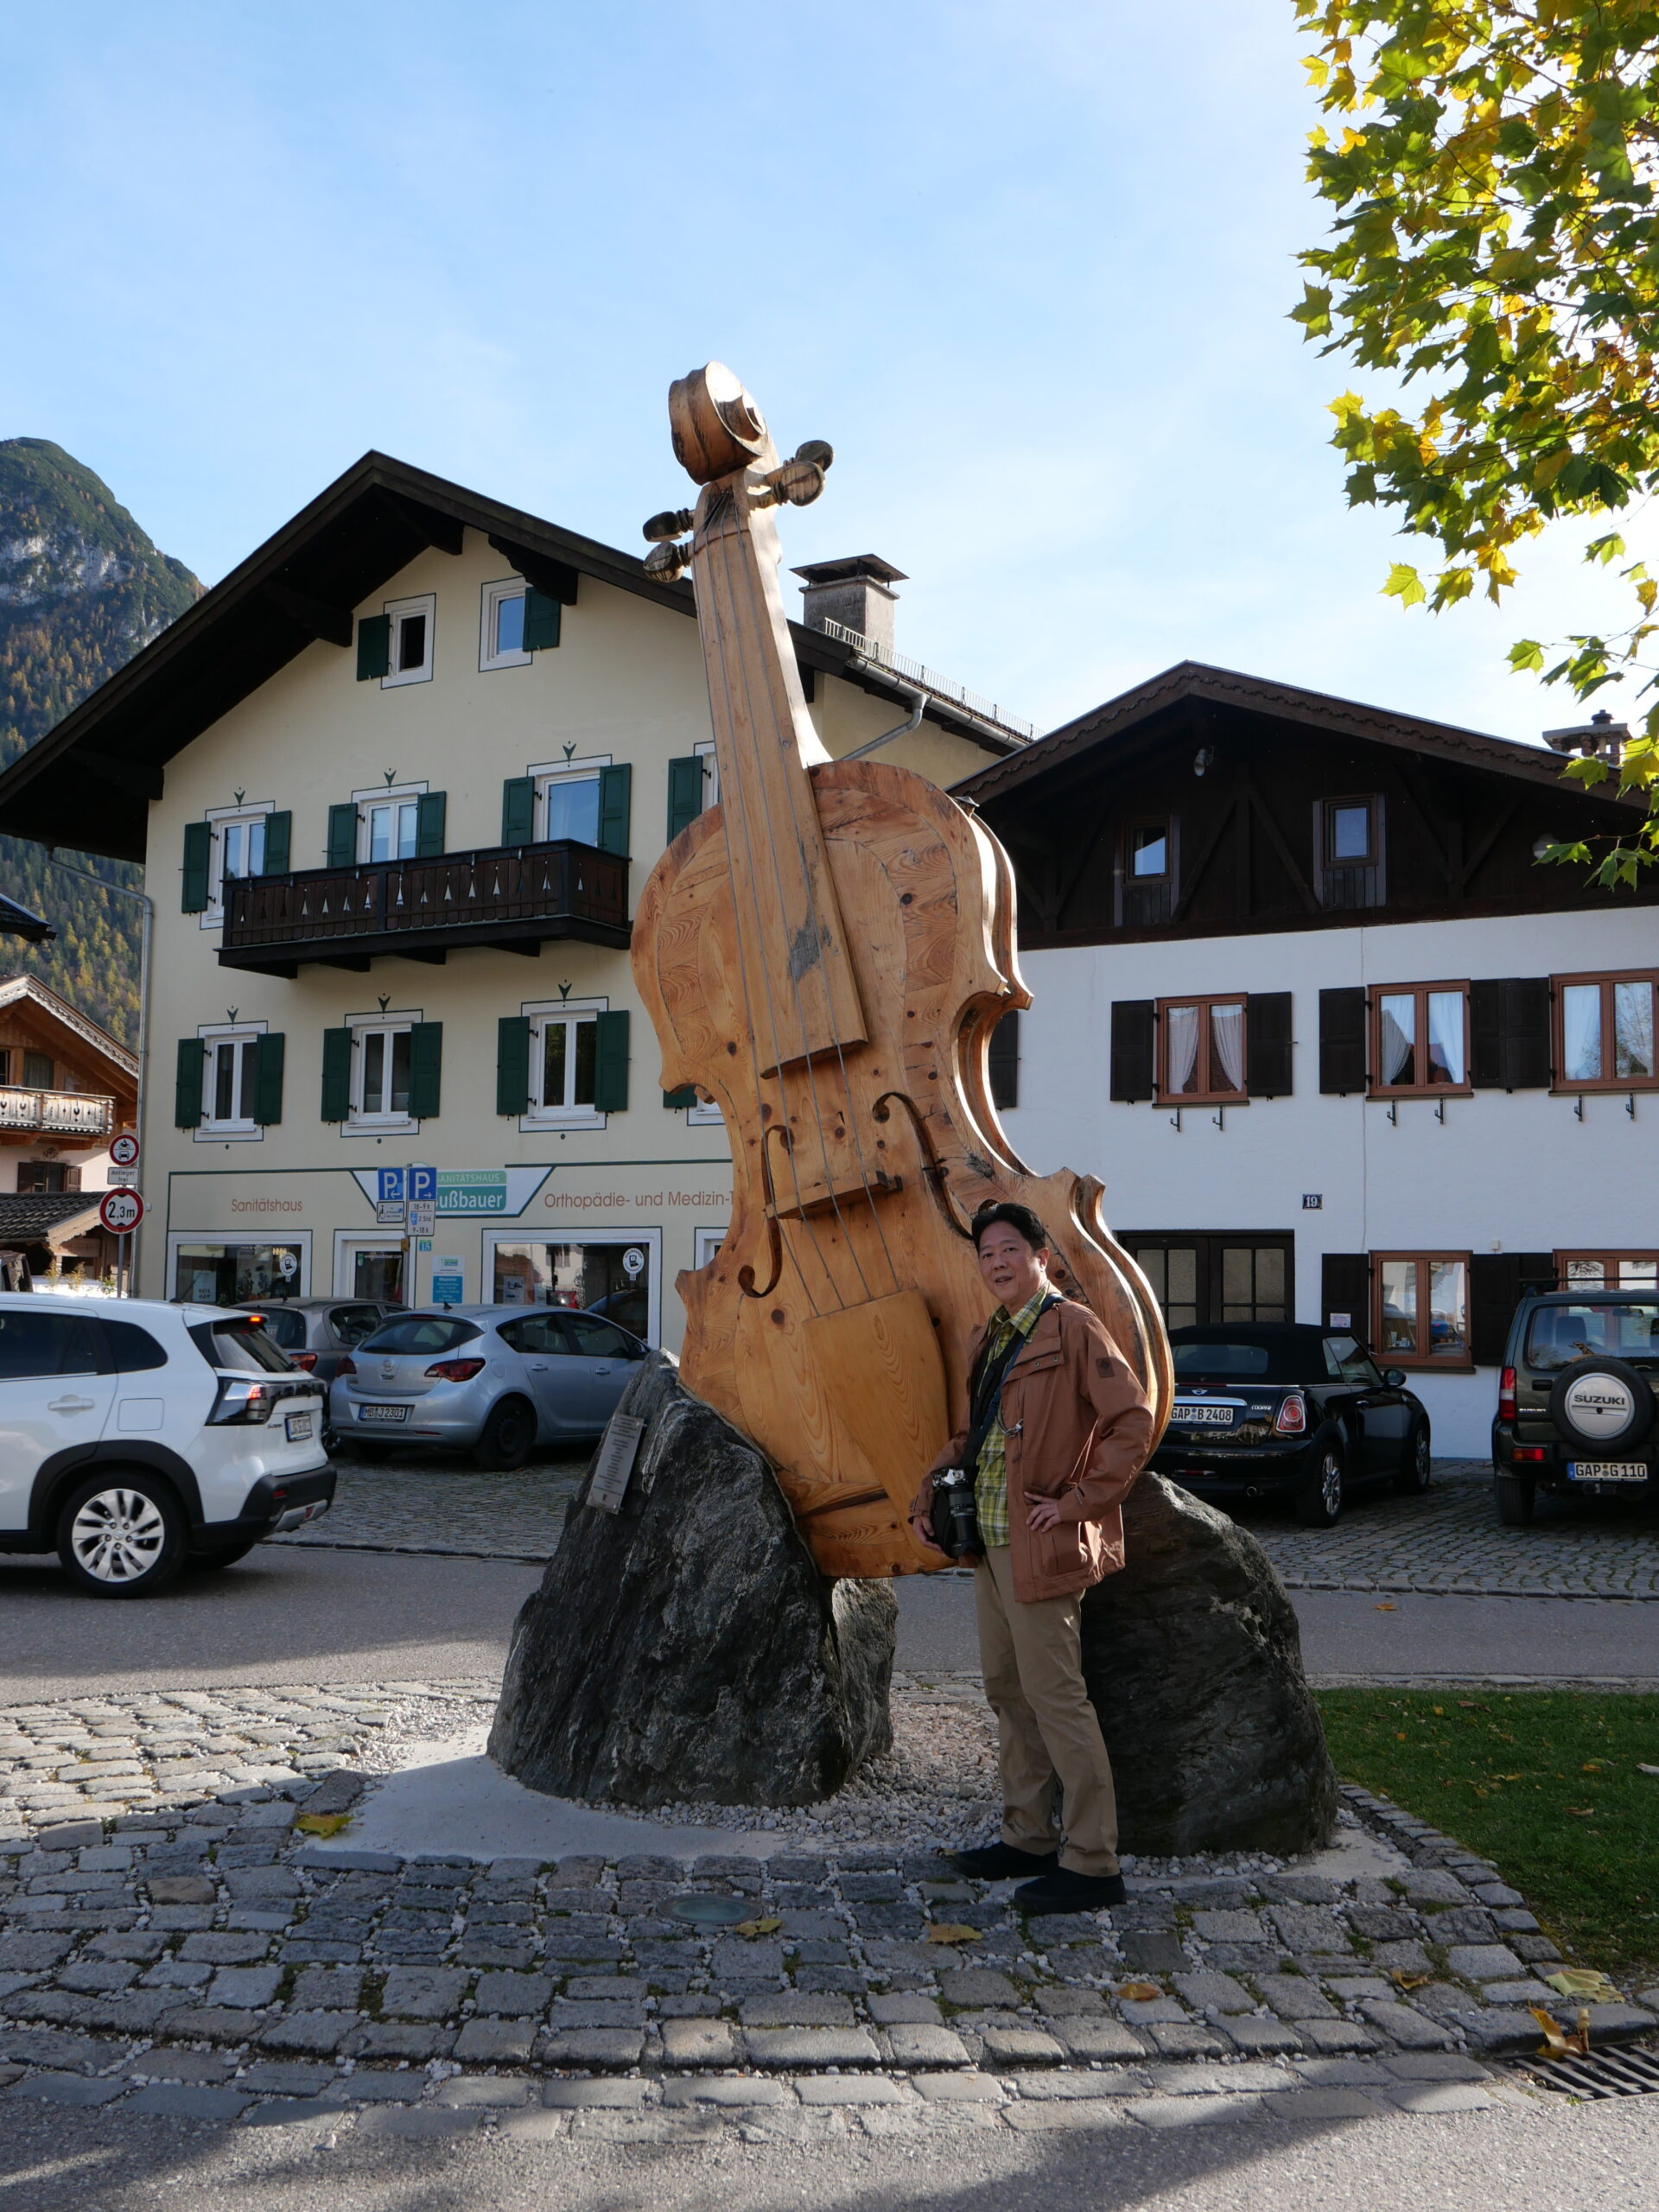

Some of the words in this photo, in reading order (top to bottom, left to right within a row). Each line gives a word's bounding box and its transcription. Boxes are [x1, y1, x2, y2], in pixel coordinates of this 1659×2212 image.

[384, 1172, 397, 1198] P
[415, 1172, 430, 1199] P
[232, 1198, 302, 1212] Sanitätshaus
[435, 1190, 503, 1208] ußbauer
[544, 1192, 630, 1210] Orthopädie-
[635, 1192, 663, 1206] und
[1306, 1196, 1318, 1208] 19
[1573, 1395, 1625, 1405] SUZUKI
[364, 1408, 374, 1418] MB
[1172, 1408, 1191, 1420] GAP
[1198, 1409, 1204, 1421] B
[1206, 1409, 1231, 1421] 2408
[1575, 1464, 1601, 1477] GAP
[1610, 1465, 1618, 1477] G
[1621, 1465, 1645, 1478] 110
